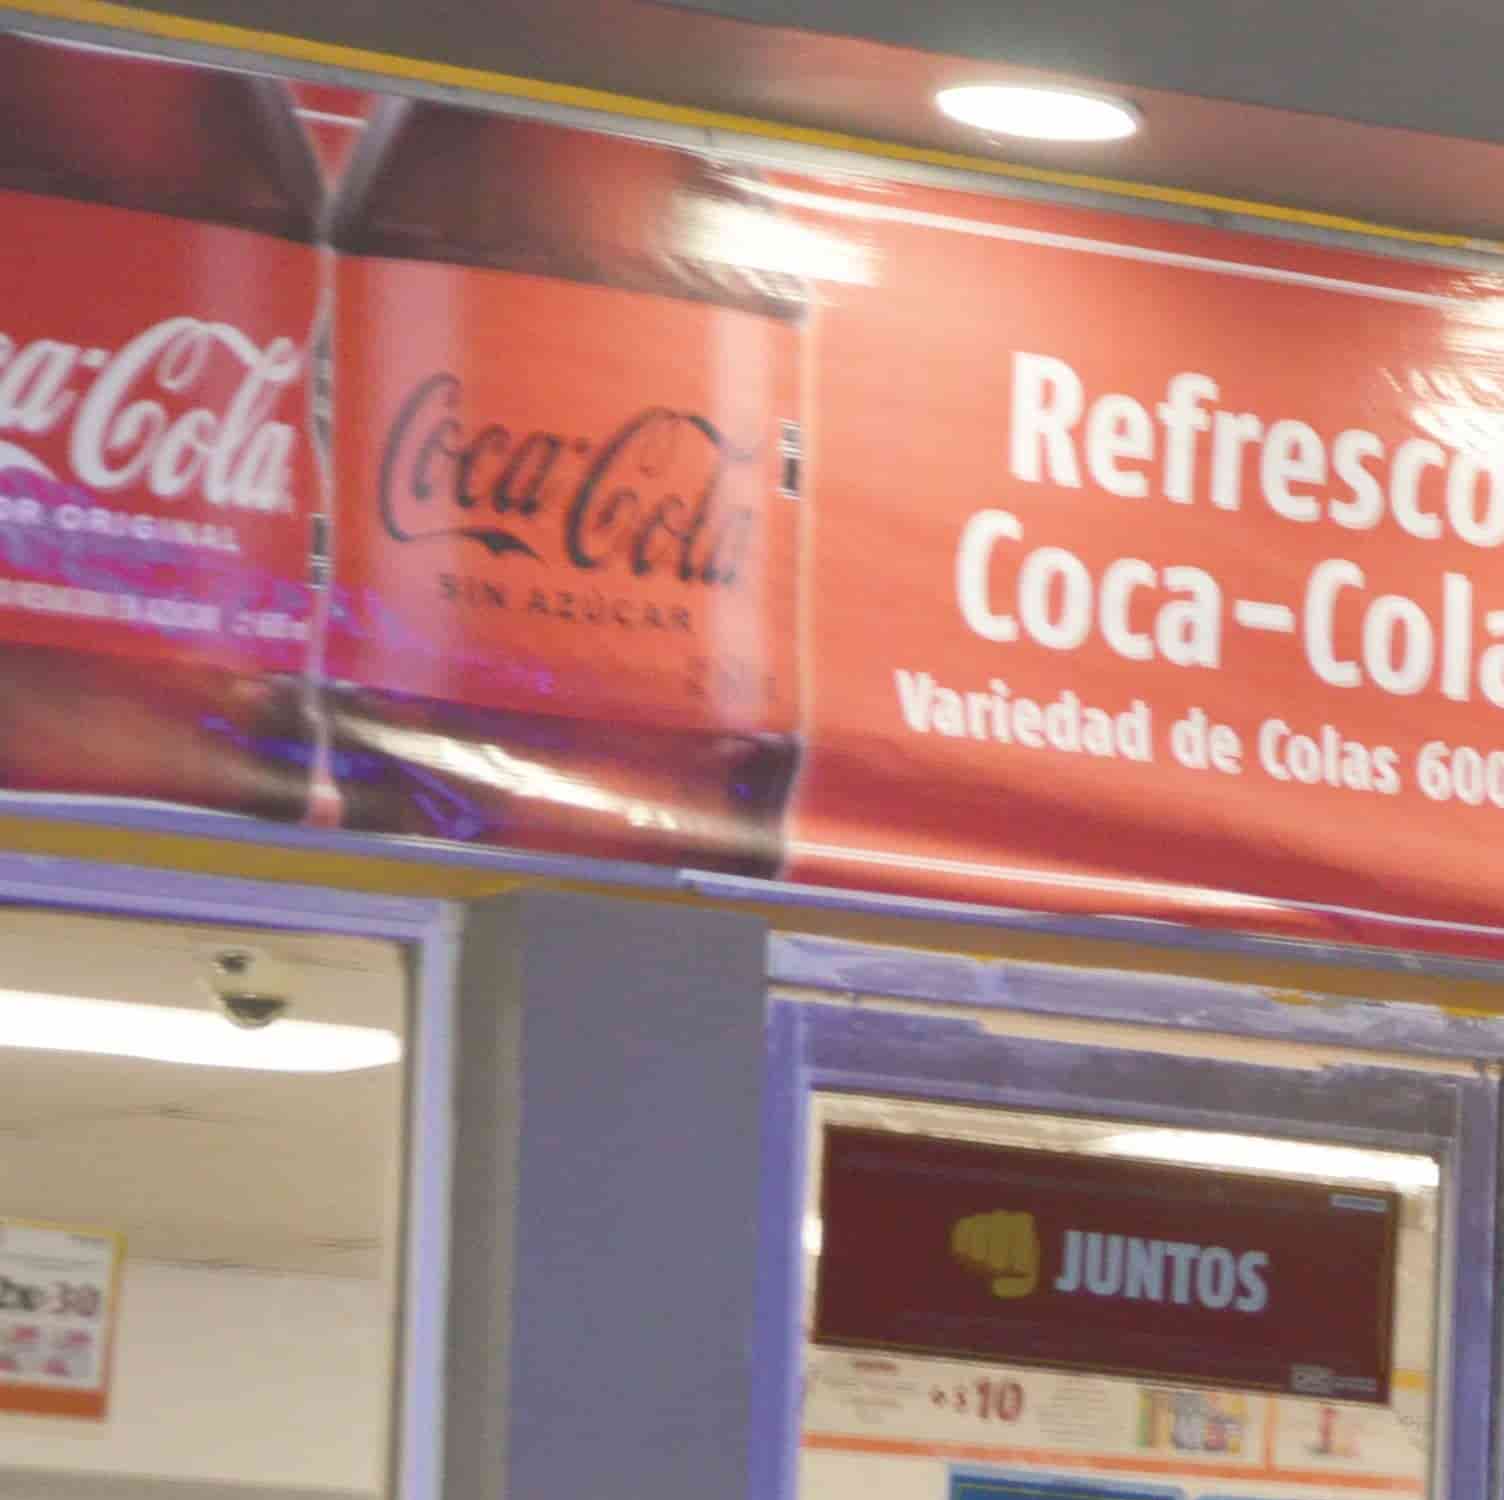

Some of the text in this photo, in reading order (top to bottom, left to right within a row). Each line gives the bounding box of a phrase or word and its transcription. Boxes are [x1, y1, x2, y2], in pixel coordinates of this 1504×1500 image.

[440, 573, 506, 609] SIN
[893, 667, 1153, 765] Variedad
[1171, 707, 1244, 777] de
[1258, 715, 1400, 796] Colas
[1053, 1229, 1271, 1313] JUNTOS
